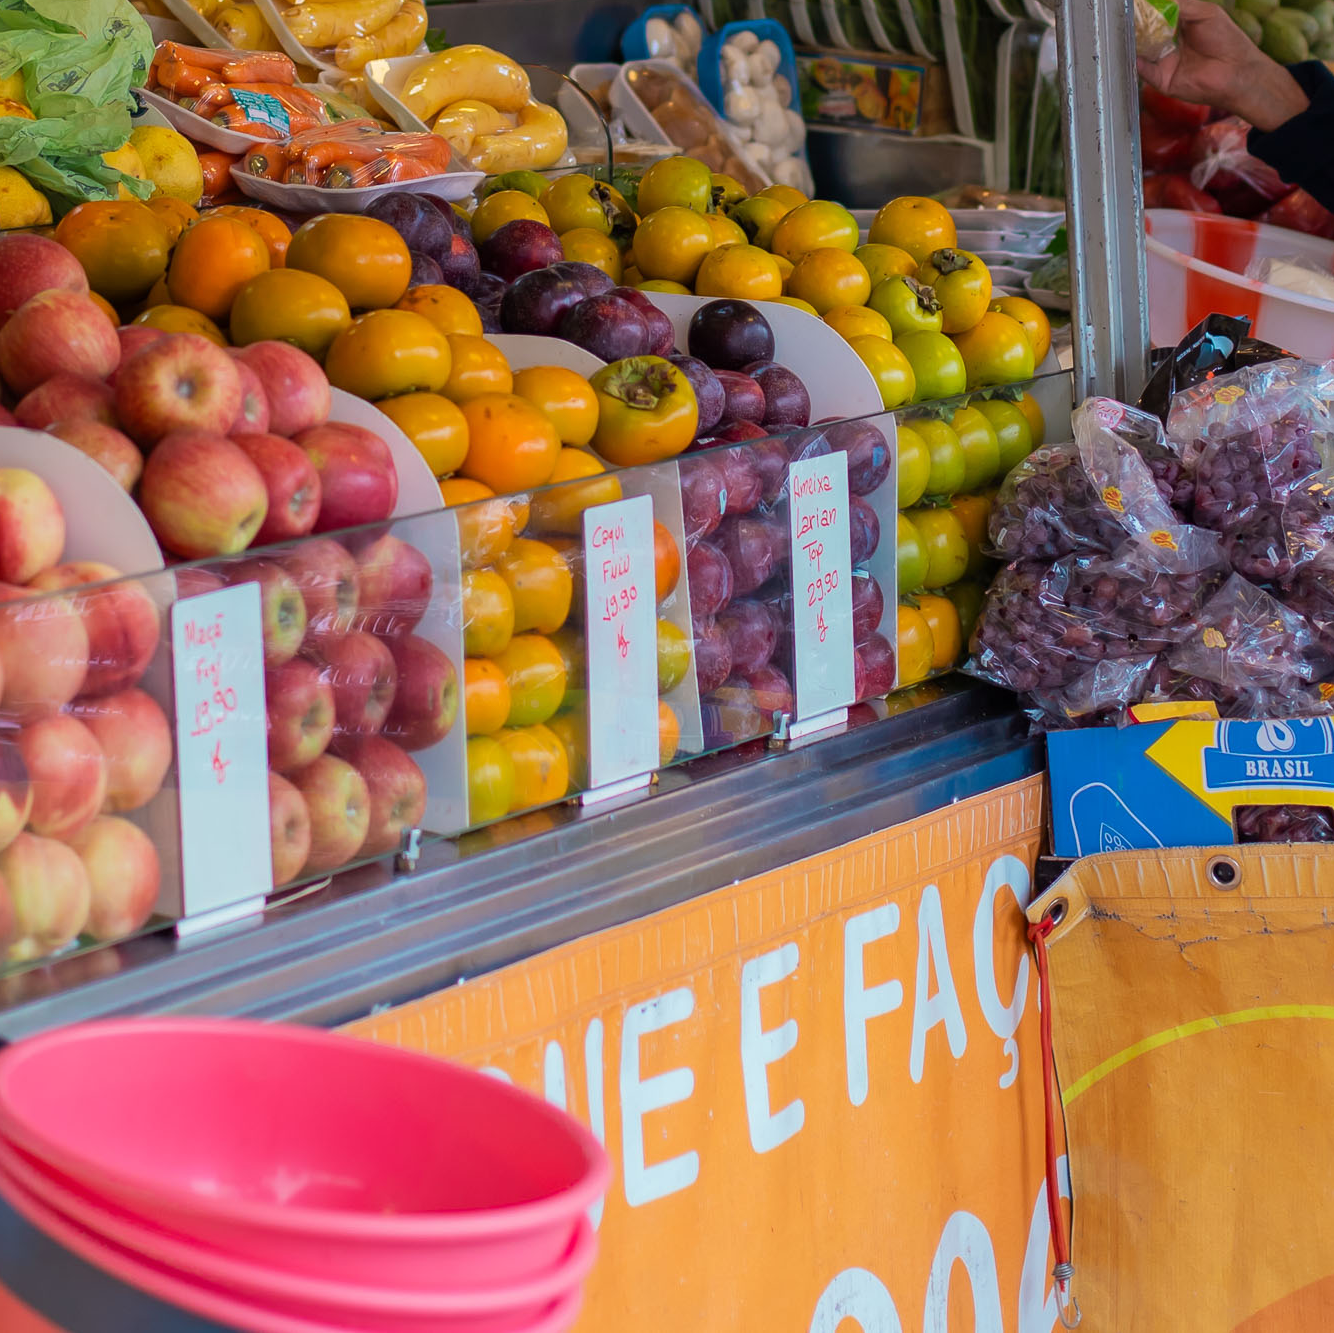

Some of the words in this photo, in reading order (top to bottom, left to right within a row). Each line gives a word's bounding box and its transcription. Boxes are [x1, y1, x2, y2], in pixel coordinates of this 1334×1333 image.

[47, 69, 83, 92] Dole
[793, 472, 832, 504] Ameixa
[592, 517, 625, 554] Caqui
[796, 506, 837, 539] Larian
[803, 540, 823, 572] Top
[185, 613, 224, 650] Maçã
[1245, 760, 1314, 778] BRASIL
[740, 942, 806, 1154] E
[843, 854, 1041, 1106] FAÇ
